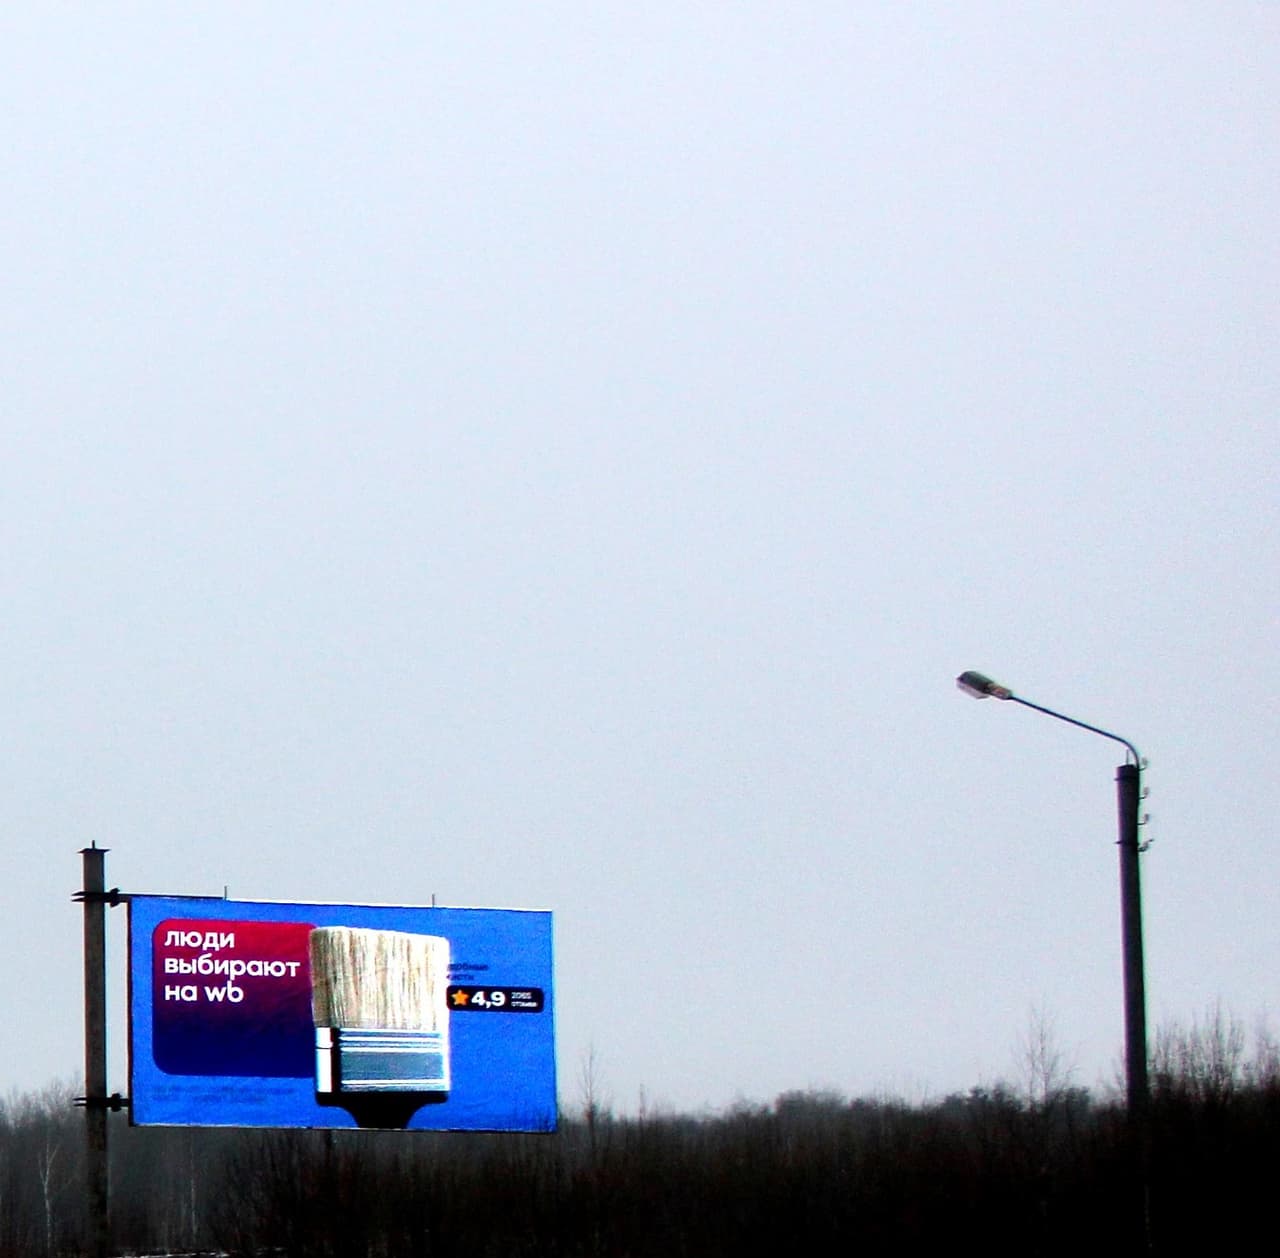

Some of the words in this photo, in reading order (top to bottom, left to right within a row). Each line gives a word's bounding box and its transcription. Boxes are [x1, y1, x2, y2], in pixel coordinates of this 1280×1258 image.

[164, 928, 235, 951] люди
[164, 952, 301, 978] выбирают
[164, 981, 198, 1002] на
[204, 980, 244, 1003] wb
[471, 990, 506, 1009] 4,9
